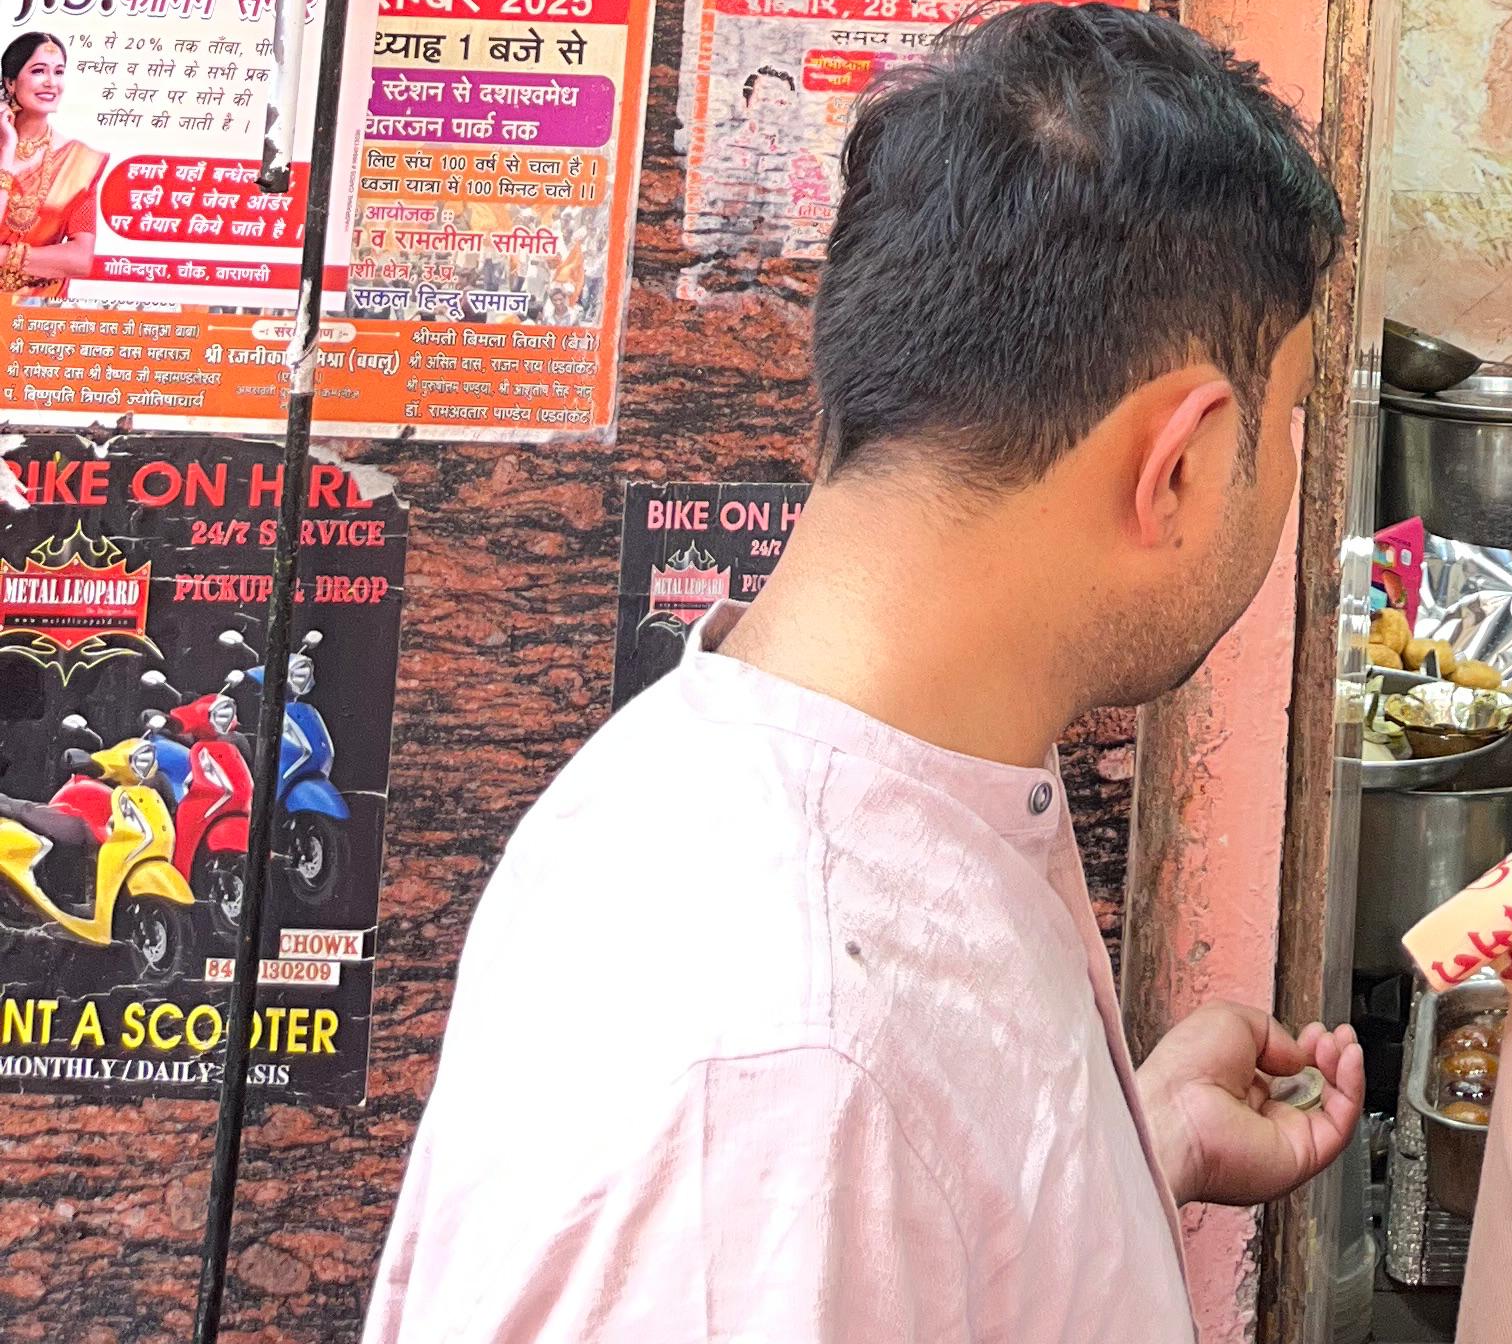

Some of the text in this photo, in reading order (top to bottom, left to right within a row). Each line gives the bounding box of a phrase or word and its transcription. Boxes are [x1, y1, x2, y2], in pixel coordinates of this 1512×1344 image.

[174, 38, 200, 53] तक
[489, 27, 588, 65] बजे से
[124, 82, 226, 107] जेवर सोने
[382, 72, 446, 104] स्टेशन
[452, 75, 472, 104] से
[178, 111, 215, 132] जाती
[452, 111, 540, 141] पार्क तक
[127, 161, 169, 182] हमारे
[202, 187, 240, 210] जेवर
[110, 211, 266, 240] पर तैयार किये जाते
[215, 260, 272, 283] वाराणसी
[352, 287, 530, 313] सकल समाज
[131, 461, 228, 508] ON
[647, 499, 710, 530] BIKE
[719, 501, 770, 532] ON
[190, 519, 386, 548] 24/7 SRVICE
[751, 538, 782, 557] 24/7
[3, 577, 140, 607] METAL LEOPARD
[314, 575, 390, 605] DROP
[279, 931, 359, 957] CHOWK
[71, 1000, 105, 1047] A
[137, 1059, 214, 1084] DAILY
